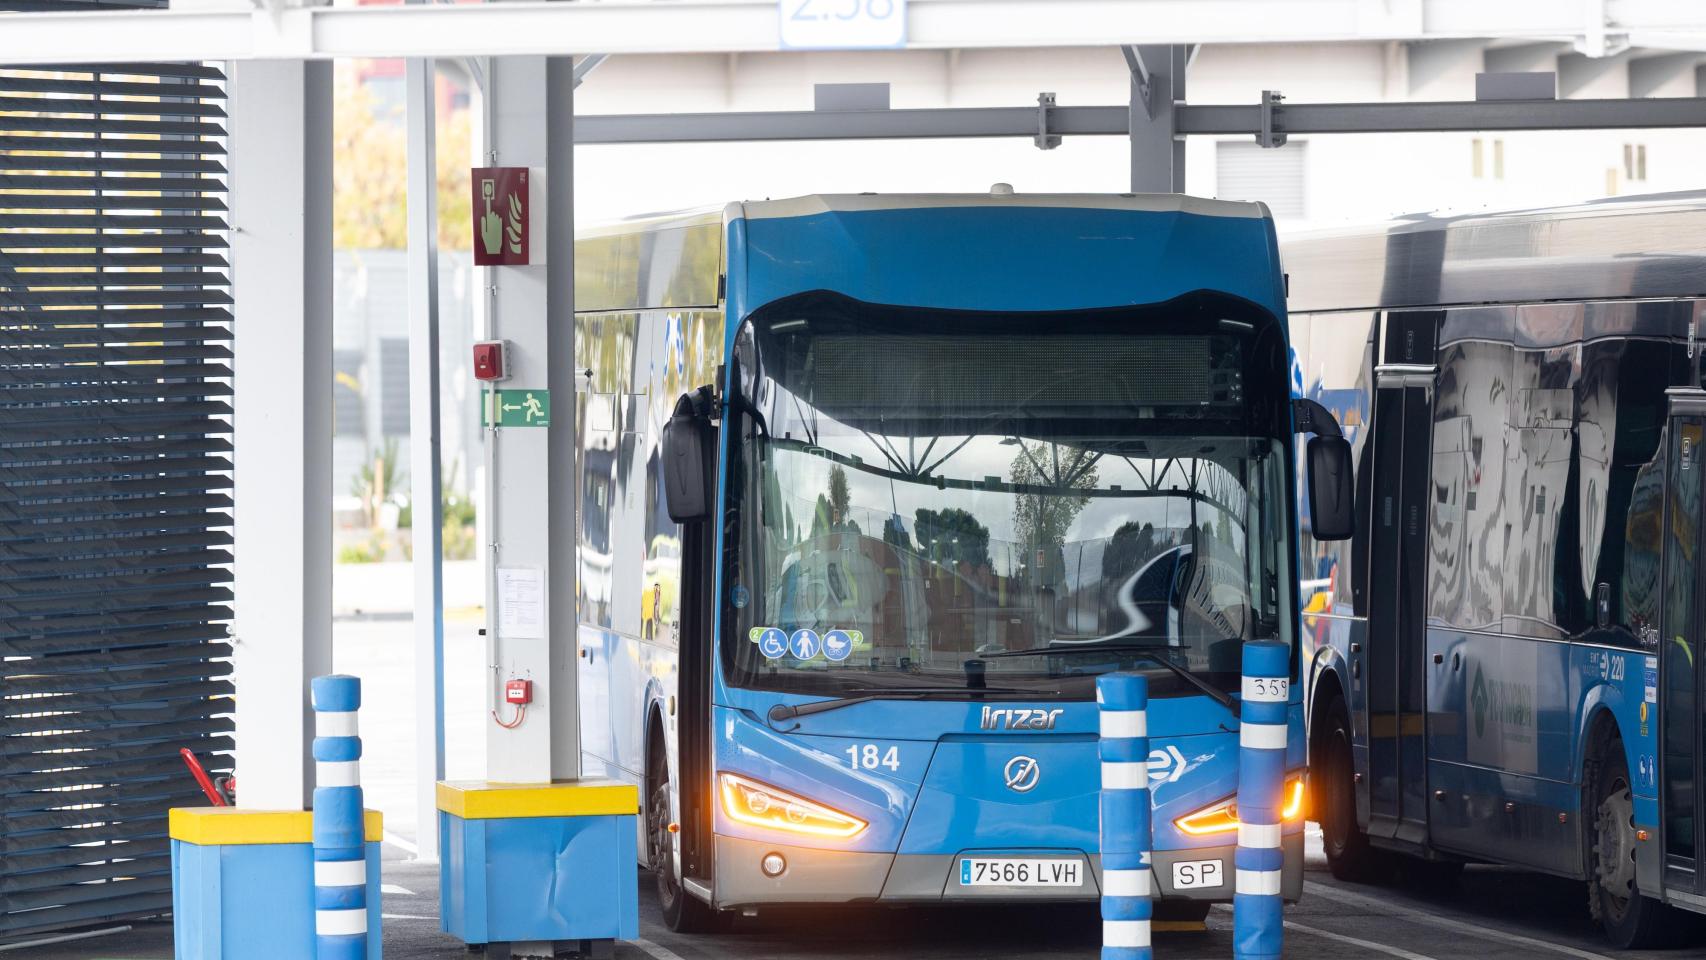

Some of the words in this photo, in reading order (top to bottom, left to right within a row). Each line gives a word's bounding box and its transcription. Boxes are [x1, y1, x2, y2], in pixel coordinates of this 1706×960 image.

[1611, 656, 1624, 681] 220
[1254, 678, 1288, 697] 359
[846, 744, 901, 774] 184
[975, 862, 1029, 882] 7566
[1038, 863, 1077, 882] LVH
